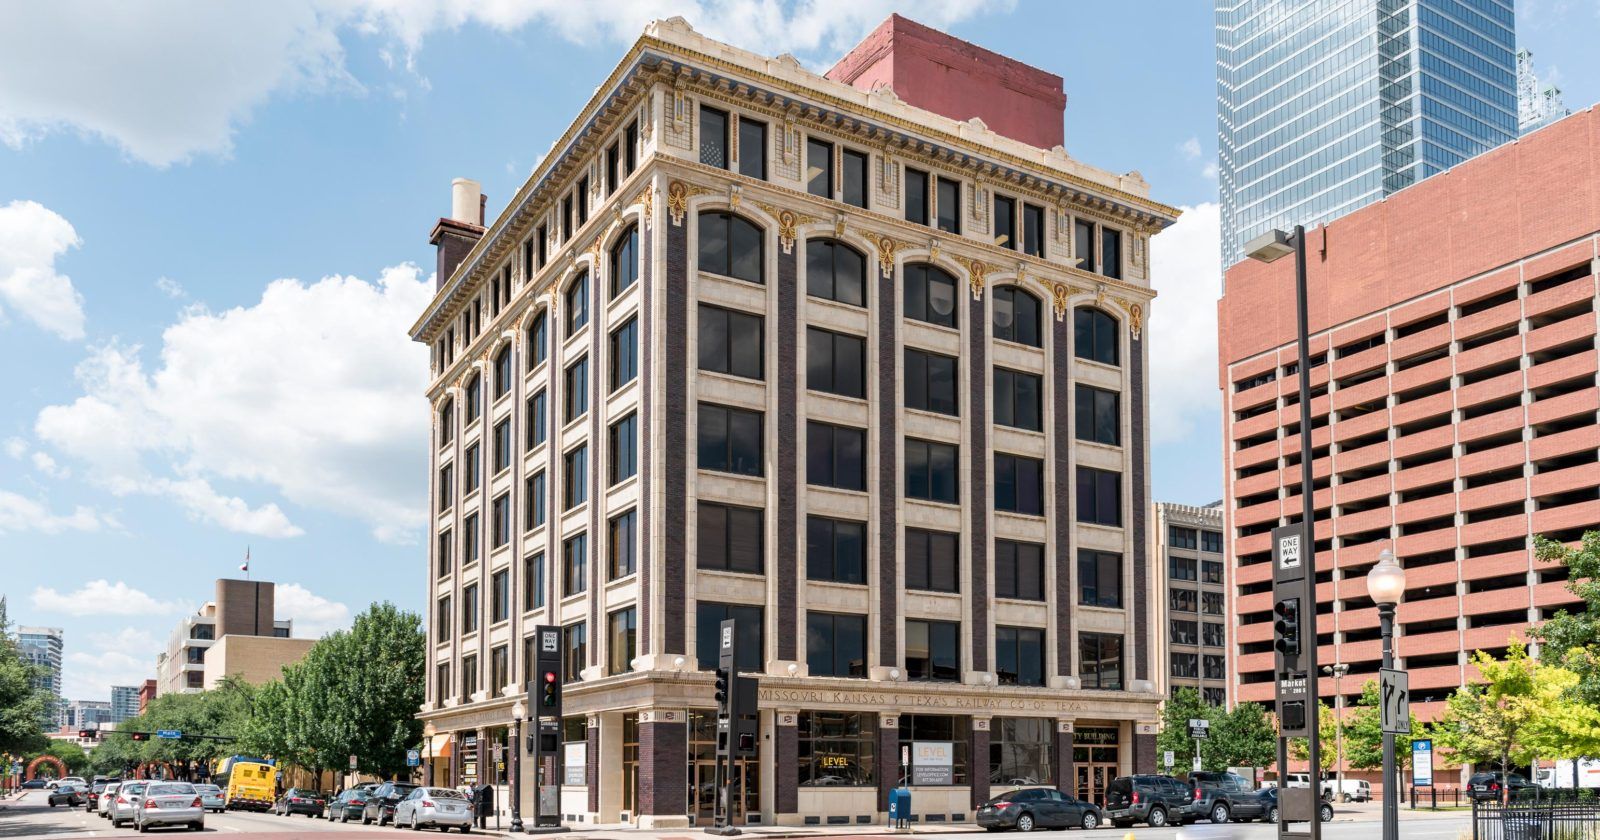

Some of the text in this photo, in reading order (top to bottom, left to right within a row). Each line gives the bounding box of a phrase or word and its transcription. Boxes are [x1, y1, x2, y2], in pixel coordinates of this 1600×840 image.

[1282, 538, 1298, 548] ONE
[1282, 547, 1298, 556] WAY
[1281, 679, 1306, 688] Market
[833, 692, 885, 705] KANSAS
[909, 695, 948, 706] TEXAS
[956, 697, 1001, 708] RAILWAY
[1056, 701, 1089, 711] TEXAS
[1084, 732, 1116, 740] BUILDING
[919, 747, 947, 757] LEVEL
[823, 757, 849, 766] LEVEL
